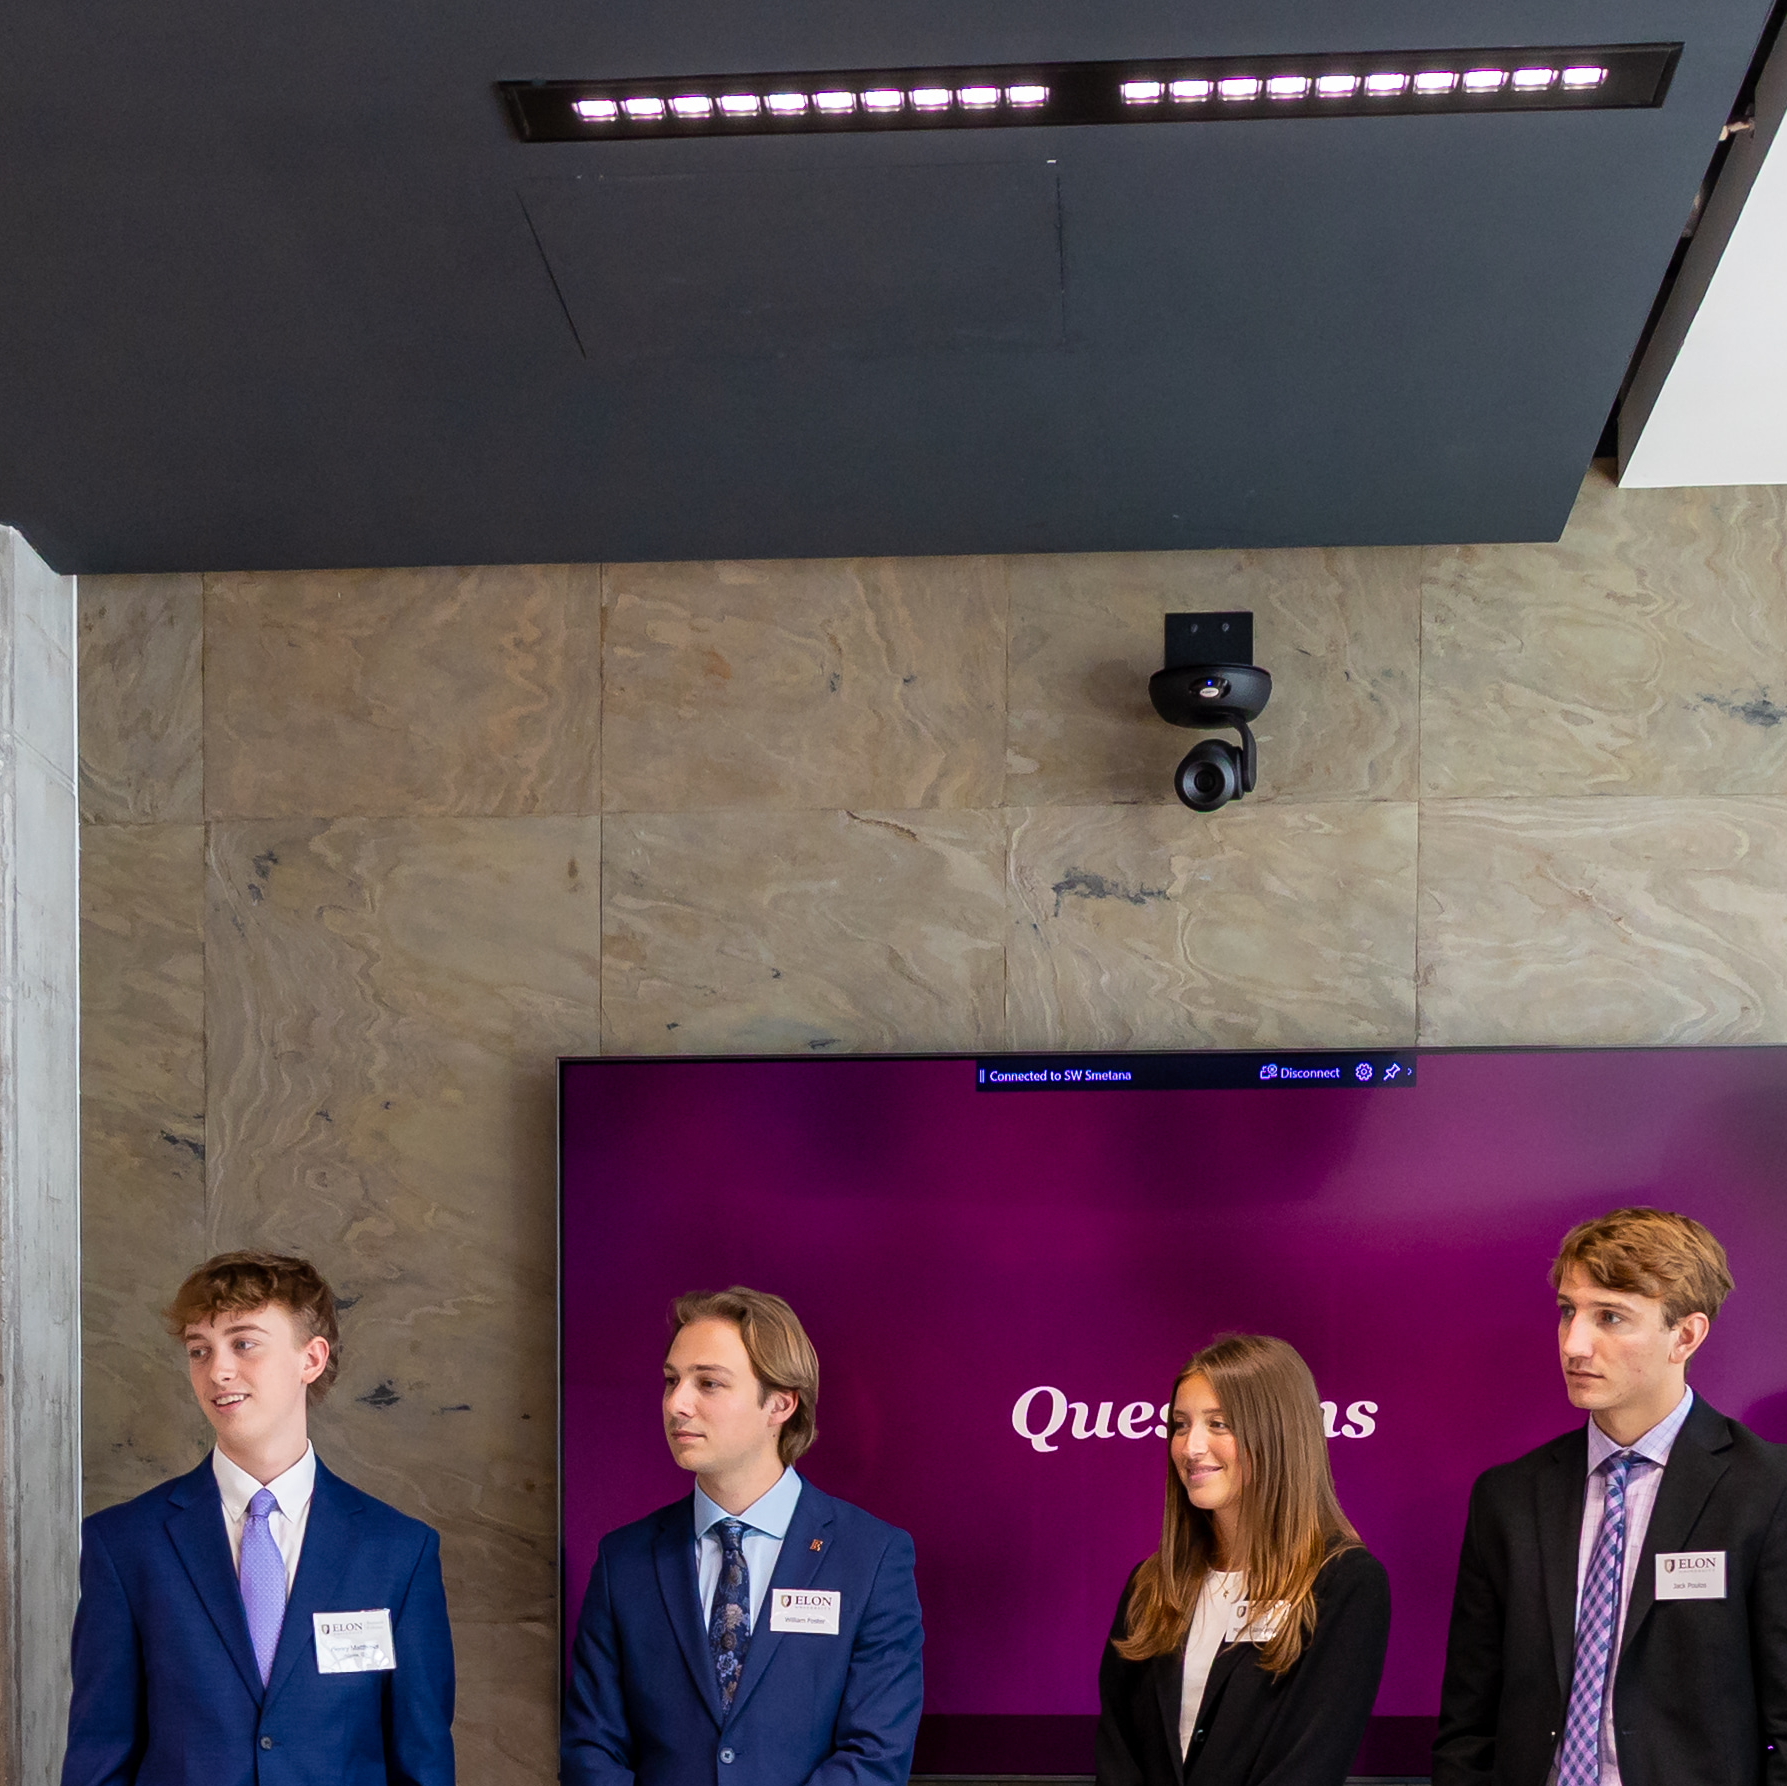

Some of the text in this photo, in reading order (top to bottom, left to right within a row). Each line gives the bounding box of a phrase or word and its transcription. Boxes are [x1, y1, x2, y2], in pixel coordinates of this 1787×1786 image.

[990, 1069, 1132, 1082] Connected to SW Smetana
[1280, 1067, 1341, 1079] Disconnect
[1678, 1557, 1716, 1570] ELON
[795, 1595, 832, 1606] ELON
[332, 1622, 363, 1633] ELON
